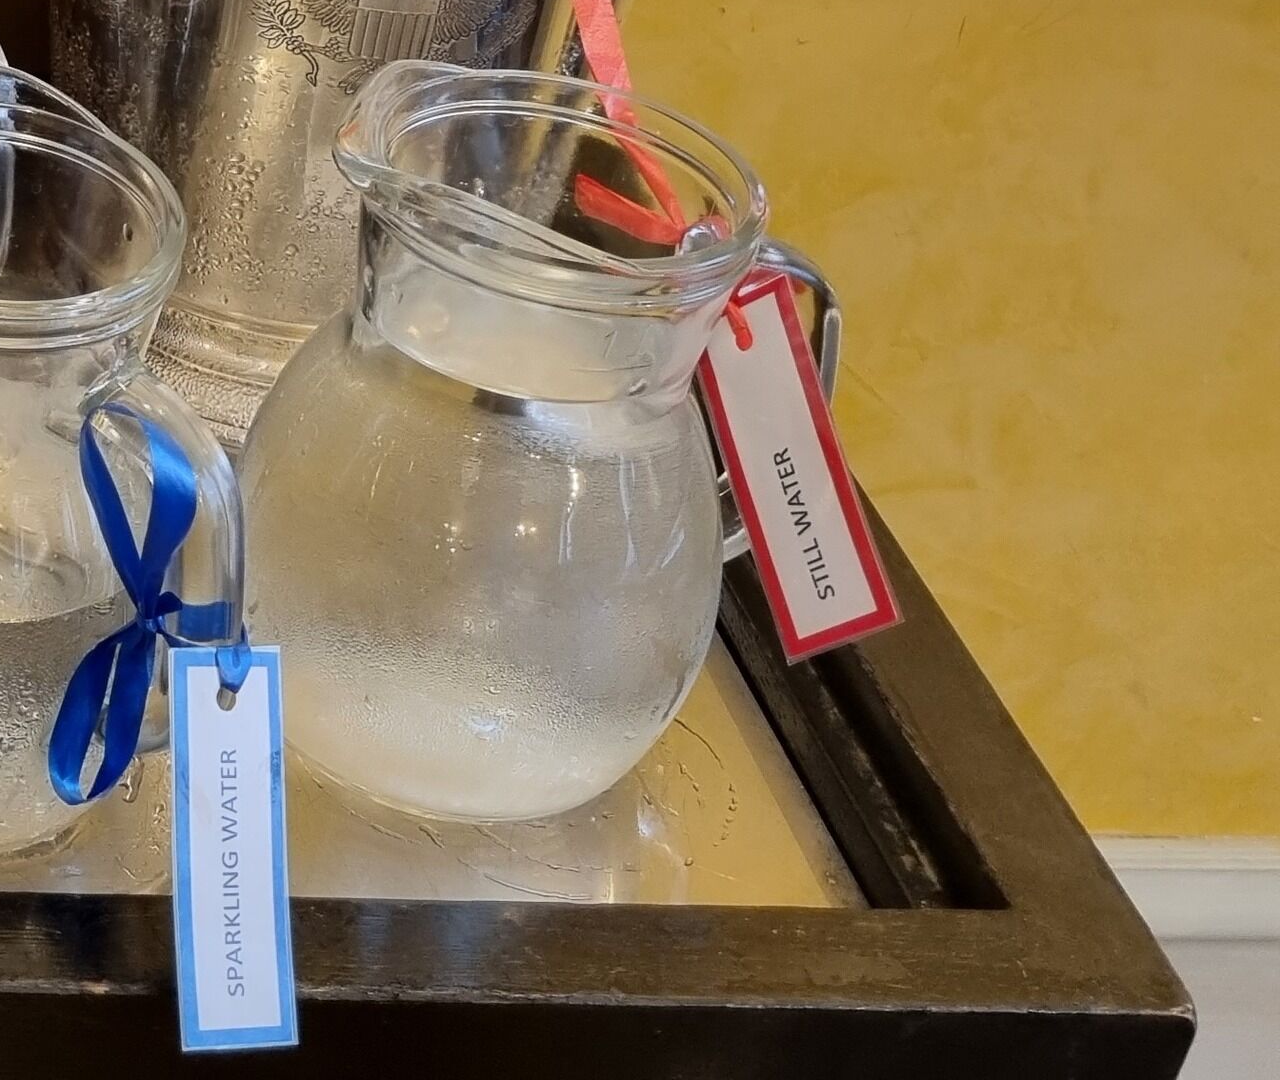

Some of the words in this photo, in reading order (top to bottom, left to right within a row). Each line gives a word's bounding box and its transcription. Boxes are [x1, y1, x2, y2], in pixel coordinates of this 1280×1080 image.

[772, 446, 813, 537] WATER
[801, 536, 836, 601] STILL
[220, 747, 239, 844] WATER
[221, 848, 246, 998] SPARKLING
